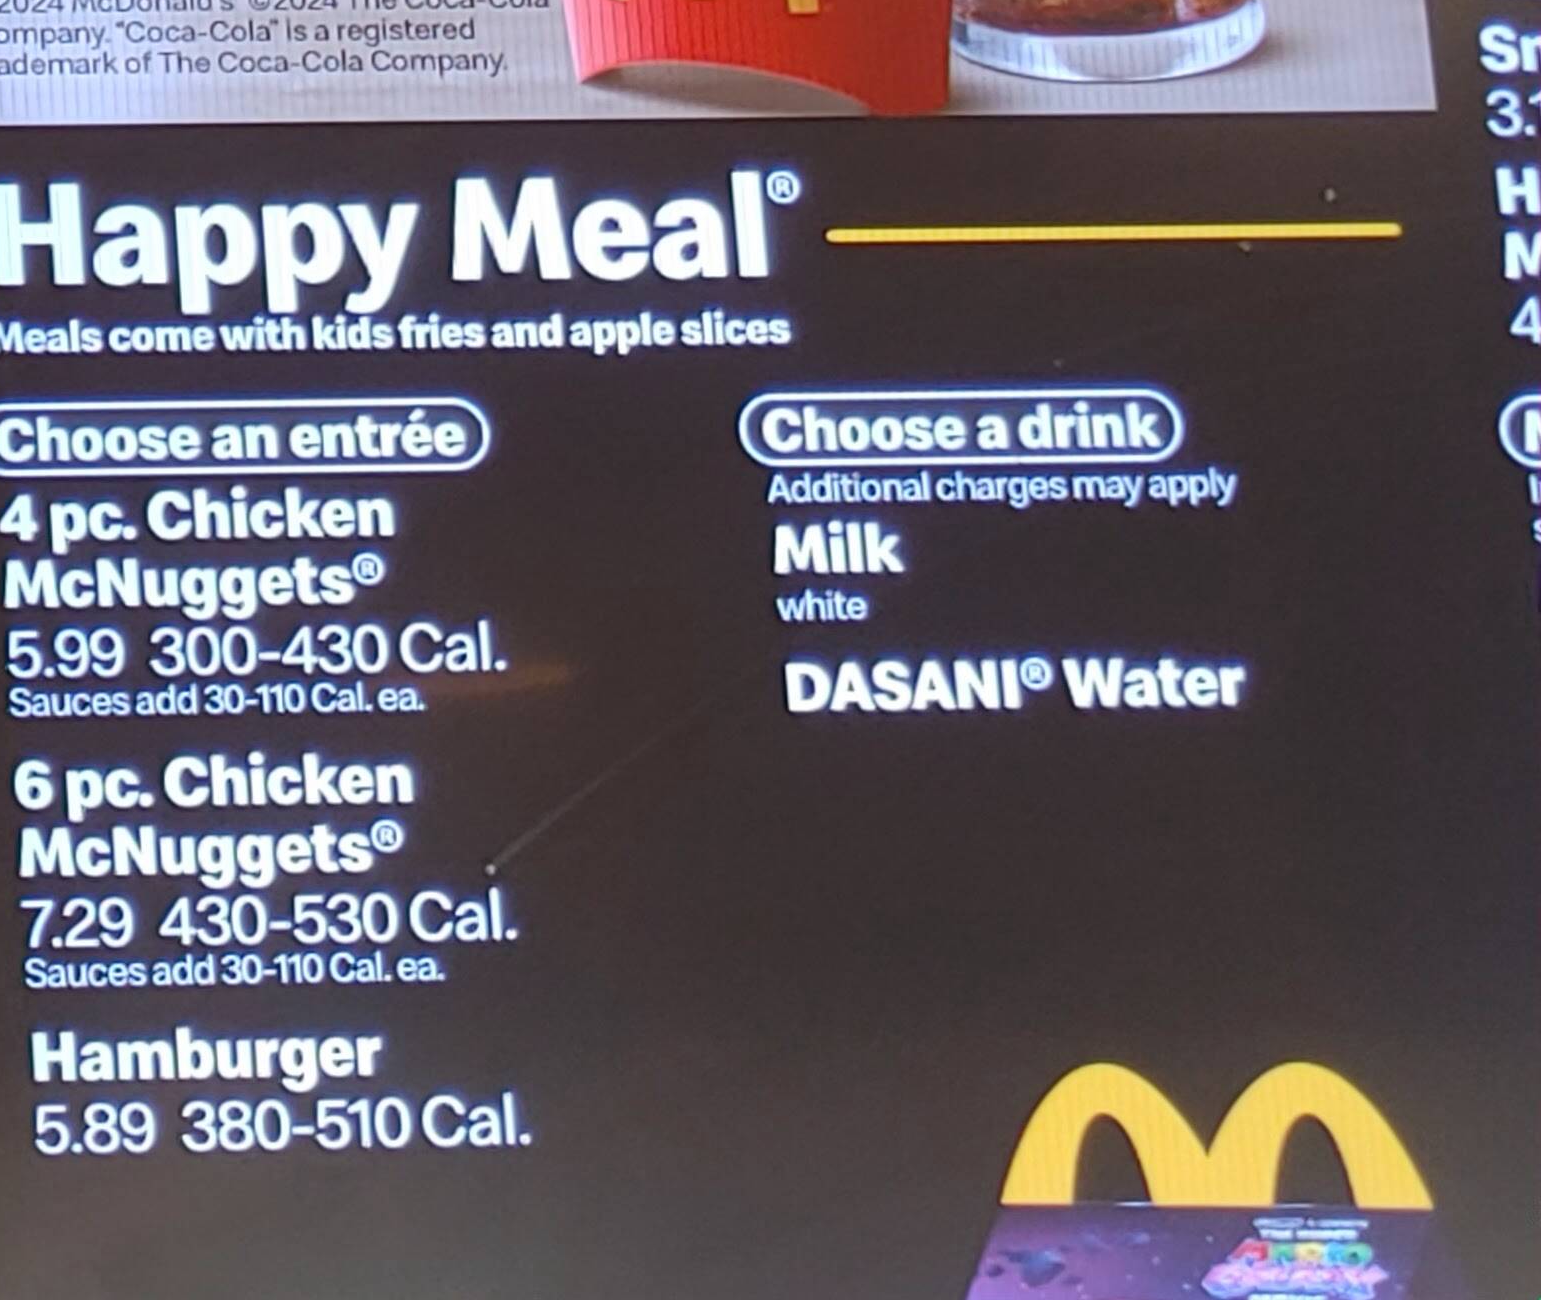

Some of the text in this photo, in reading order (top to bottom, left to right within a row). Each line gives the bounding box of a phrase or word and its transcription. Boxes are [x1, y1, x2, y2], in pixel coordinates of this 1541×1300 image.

[115, 18, 279, 44] "Coca-Cola"
[285, 18, 308, 42] is
[313, 22, 330, 42] a
[337, 17, 476, 48] registered
[124, 51, 153, 75] of
[157, 50, 211, 74] The
[217, 49, 365, 74] Coca-Cola
[370, 49, 509, 78] Company.
[108, 325, 215, 354] come
[218, 315, 308, 352] with
[311, 315, 396, 351] kids
[397, 311, 487, 350] fries
[490, 312, 565, 349] and
[568, 310, 676, 357] apple
[679, 309, 792, 347] slices
[211, 422, 280, 460] an
[288, 409, 467, 459] entrée
[760, 399, 1164, 454] Choose a drink
[766, 465, 1238, 509] Additional charges may apply
[49, 500, 138, 555] pc.
[146, 484, 396, 542] Chicken
[772, 519, 906, 575] Milk
[775, 588, 868, 623] white
[6, 618, 509, 680] 5.99 300-430 Cal.
[8, 680, 427, 719] Sauces add 30-110 Cal. ea.
[1061, 656, 1248, 711] Water
[13, 750, 415, 823] 6 pc. Chicken
[19, 886, 520, 950] 7.29 430-530 Cal.
[23, 950, 447, 990] Sauces add 30-110 Cal. ea.
[30, 1025, 383, 1094] Hamburger
[33, 1089, 534, 1156] 5.89 380-510 Cal.
